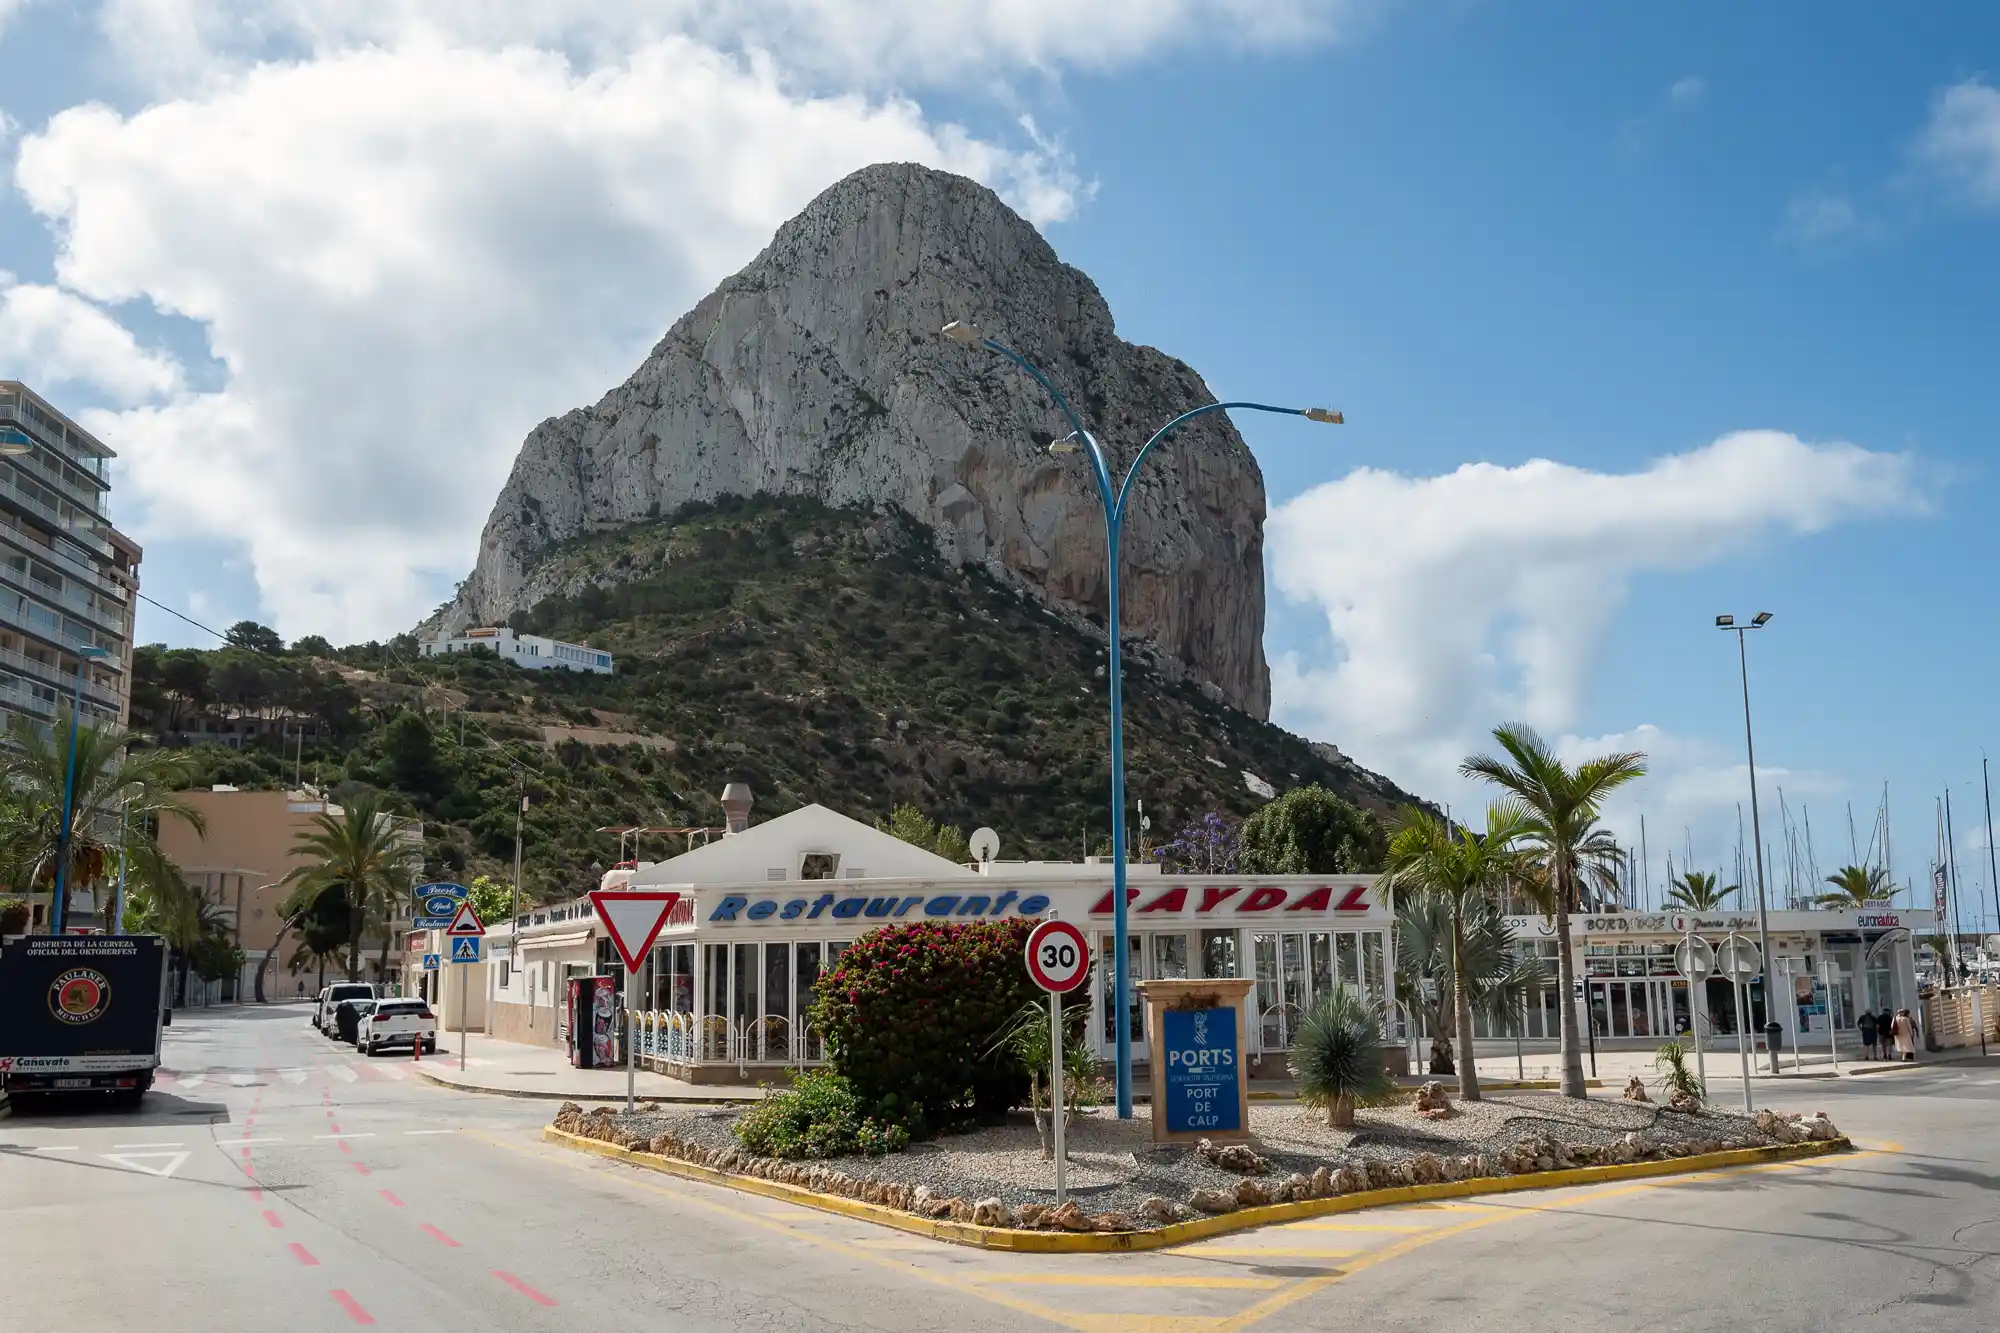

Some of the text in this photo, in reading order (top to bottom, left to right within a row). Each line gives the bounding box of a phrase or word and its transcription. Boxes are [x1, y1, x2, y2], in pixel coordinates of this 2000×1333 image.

[426, 884, 458, 894] Puerto
[708, 890, 1051, 921] Restaurante
[1088, 887, 1372, 914] BAYDAL
[1503, 919, 1528, 928] COS
[1584, 916, 1666, 932] BORDADOS
[32, 940, 134, 948] DISFRUTA DE LA CERVEZA
[27, 948, 138, 956] OFICIAL DEL OKTOBERFEST
[1042, 945, 1075, 968] 30
[53, 970, 107, 991] PAULANER
[16, 1056, 70, 1067] Cañavate
[1169, 1048, 1233, 1067] PORTS
[1186, 1088, 1219, 1099] PORT
[1195, 1102, 1211, 1112] DE
[1188, 1115, 1219, 1127] CALP
